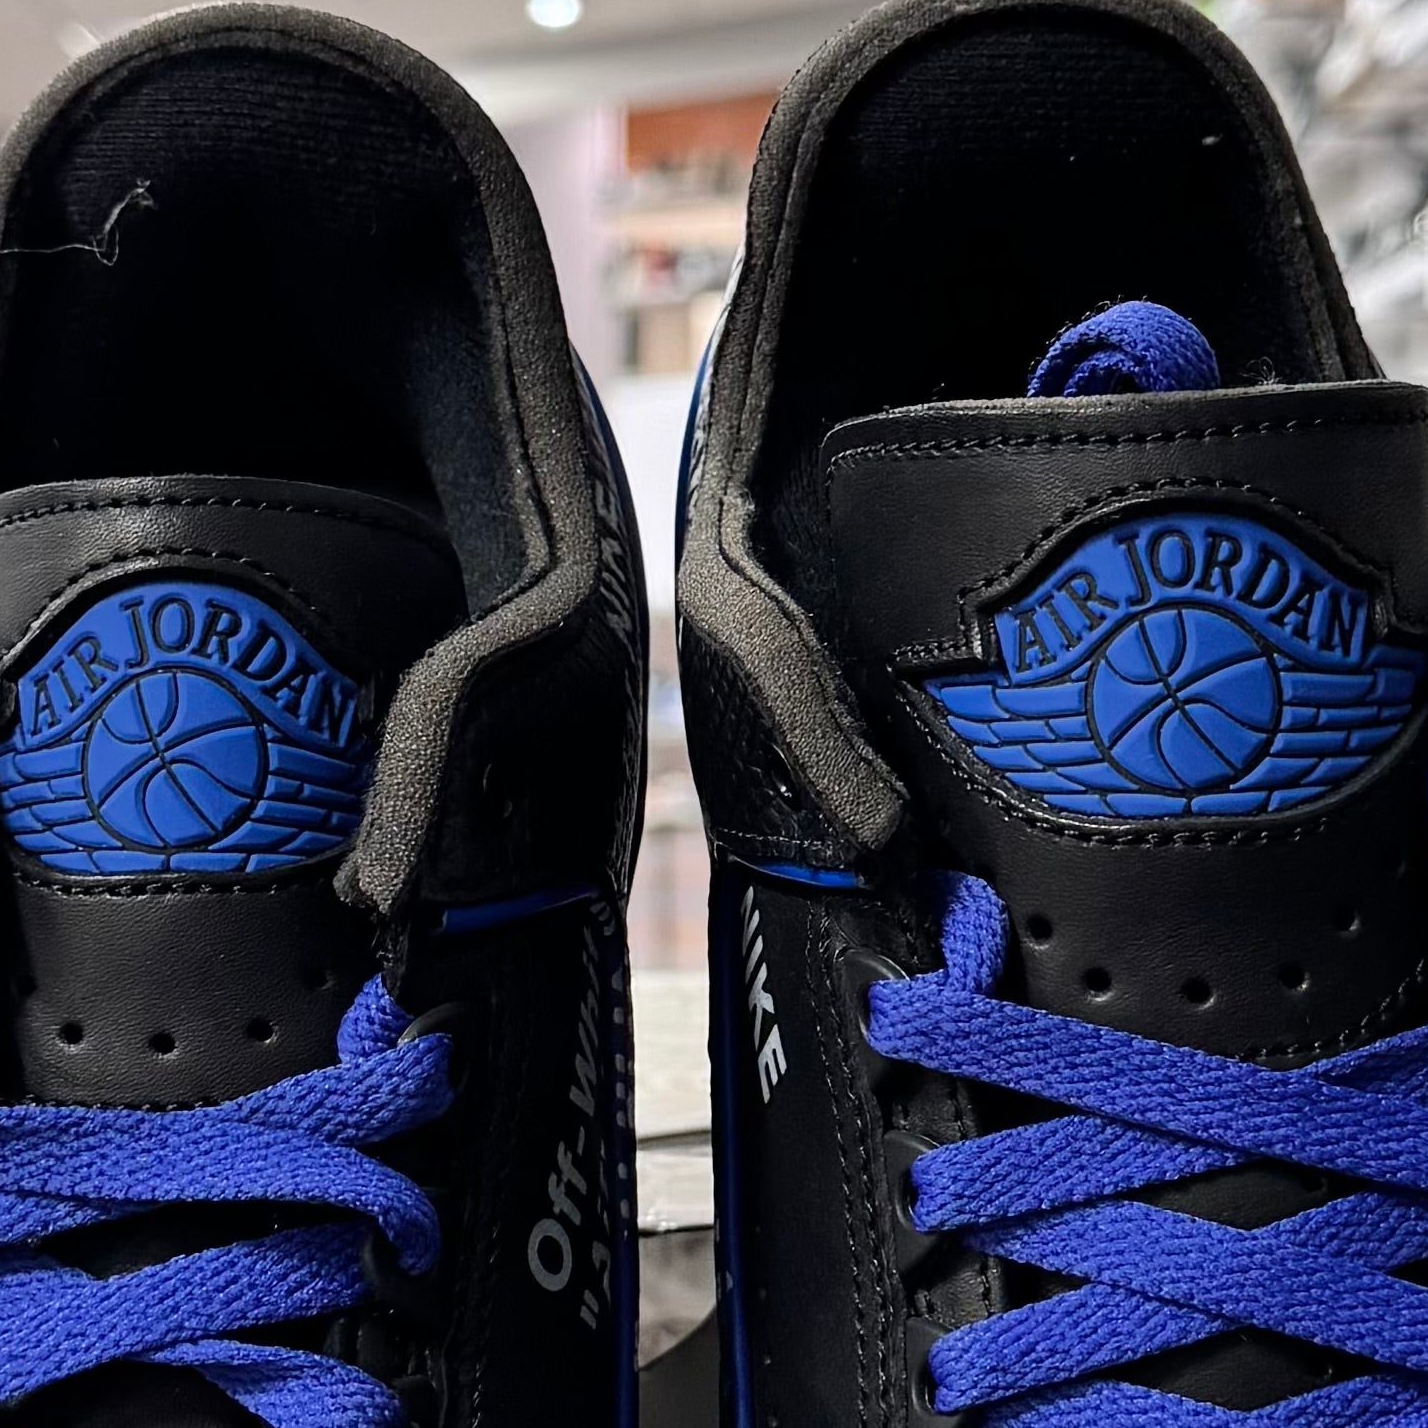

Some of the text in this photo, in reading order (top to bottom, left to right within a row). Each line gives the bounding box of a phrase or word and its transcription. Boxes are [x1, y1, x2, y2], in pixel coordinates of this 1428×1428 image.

[29, 592, 357, 746] AIR JORDAN
[1014, 528, 1362, 670] AIR JORDAN
[740, 885, 787, 1104] NIKE
